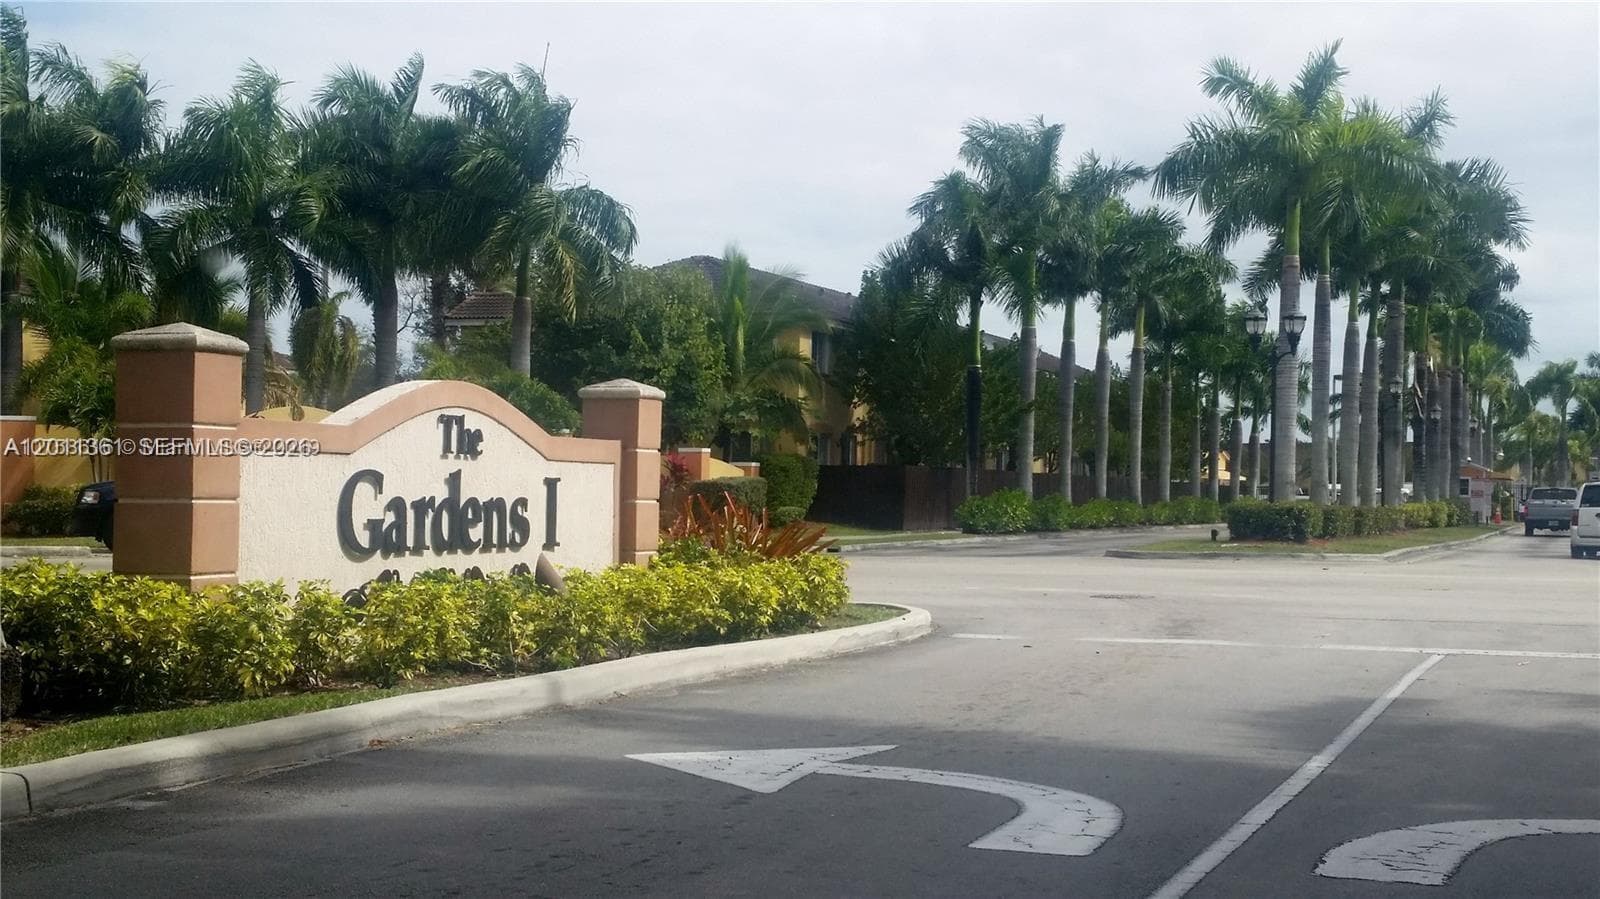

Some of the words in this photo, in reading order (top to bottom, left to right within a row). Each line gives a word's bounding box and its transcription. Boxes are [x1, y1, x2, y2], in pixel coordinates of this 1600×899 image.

[436, 413, 484, 459] The
[338, 468, 531, 563] Gardens
[542, 476, 561, 551] I
